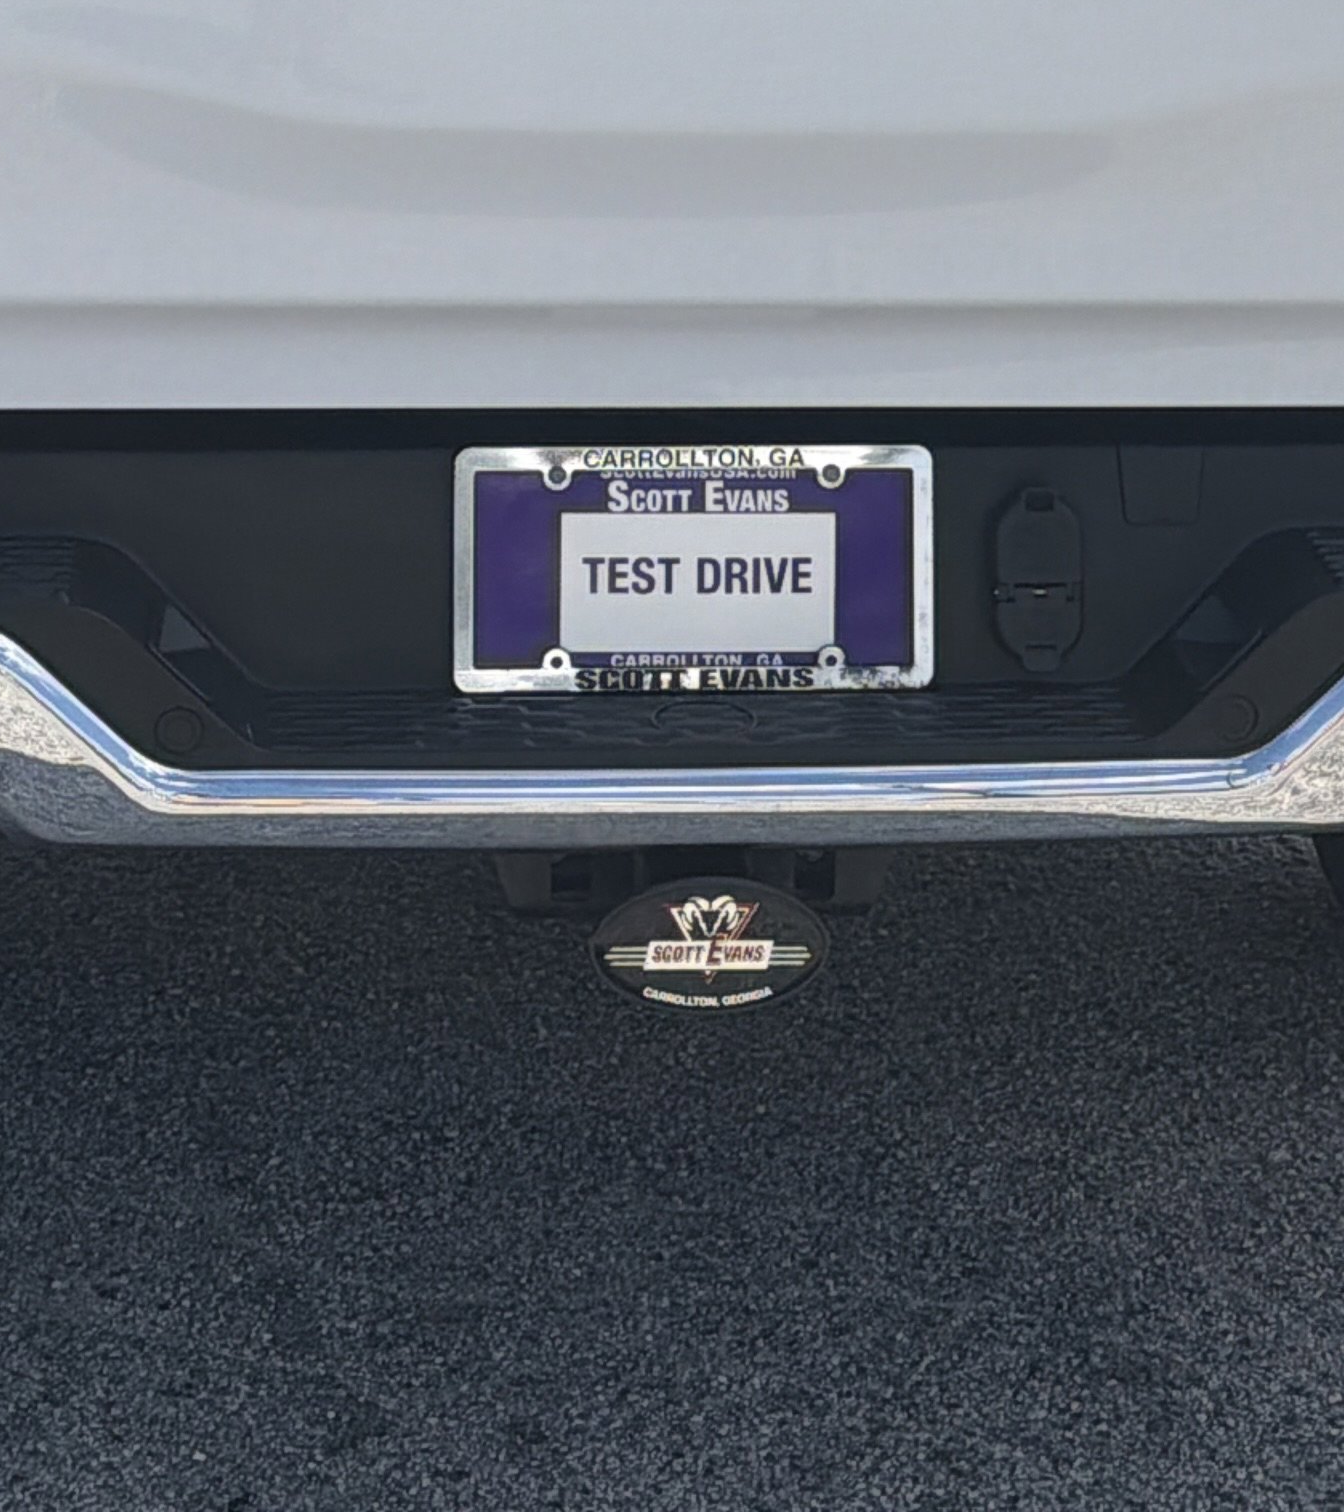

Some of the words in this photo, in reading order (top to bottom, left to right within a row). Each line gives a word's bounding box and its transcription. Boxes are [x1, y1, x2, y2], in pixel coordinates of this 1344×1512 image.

[584, 448, 760, 469] CARROLLTON,
[769, 448, 805, 467] GA
[582, 557, 681, 595] TEST
[697, 557, 813, 595] DRIVE
[575, 668, 688, 690] SCOTT
[700, 668, 815, 689] EVANS
[651, 945, 706, 963] SCOTT
